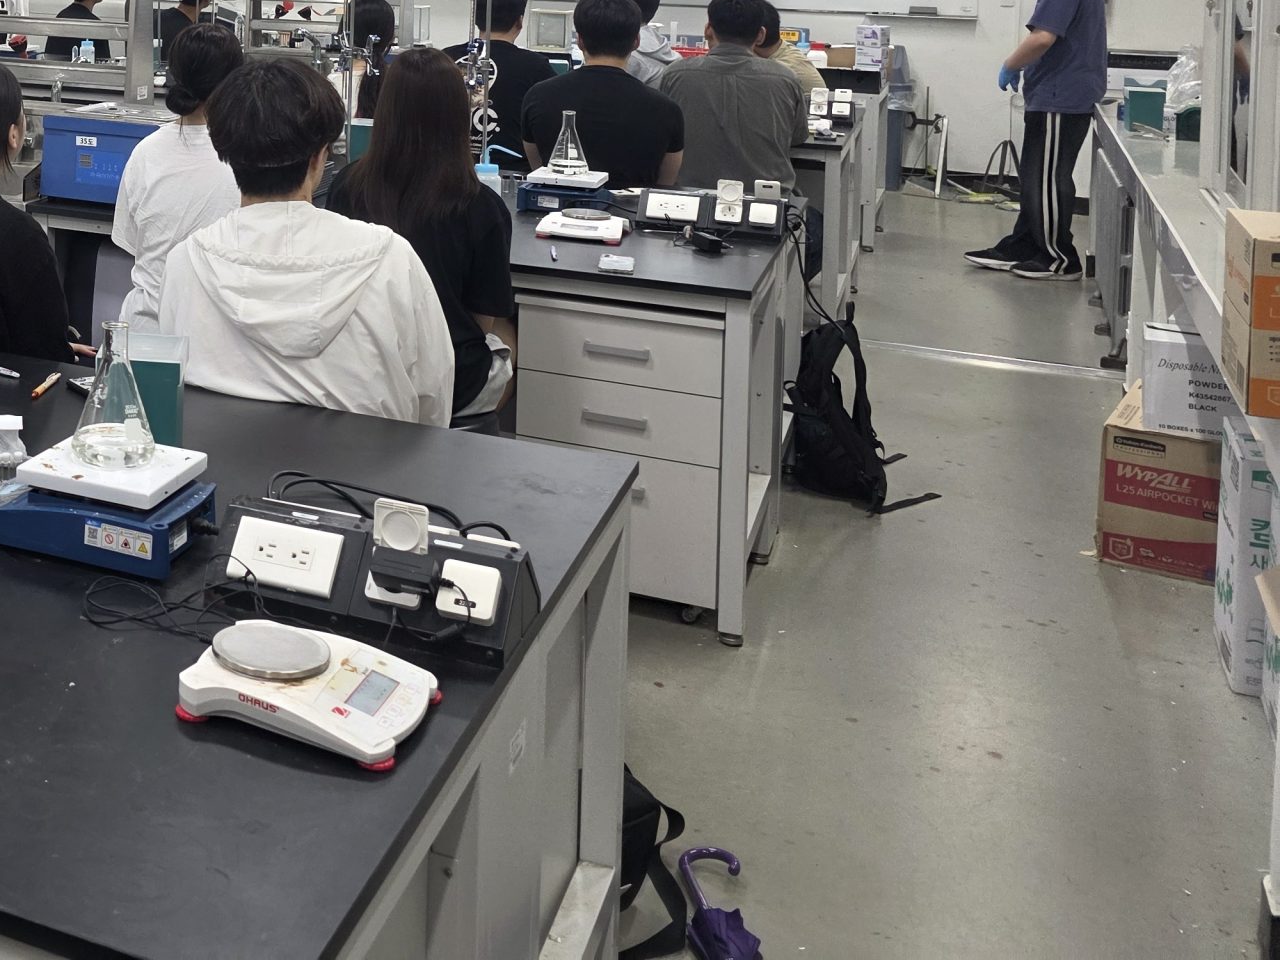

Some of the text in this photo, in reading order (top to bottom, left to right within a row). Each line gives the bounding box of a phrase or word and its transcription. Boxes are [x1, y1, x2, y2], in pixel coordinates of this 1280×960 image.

[80, 137, 94, 145] 35도
[1158, 358, 1208, 372] Disposable
[1188, 403, 1217, 412] BLACK
[1167, 424, 1188, 432] BOXES
[1116, 484, 1135, 495] L25
[1137, 487, 1199, 506] AIRPOCKET
[238, 693, 279, 713] OHAUS
